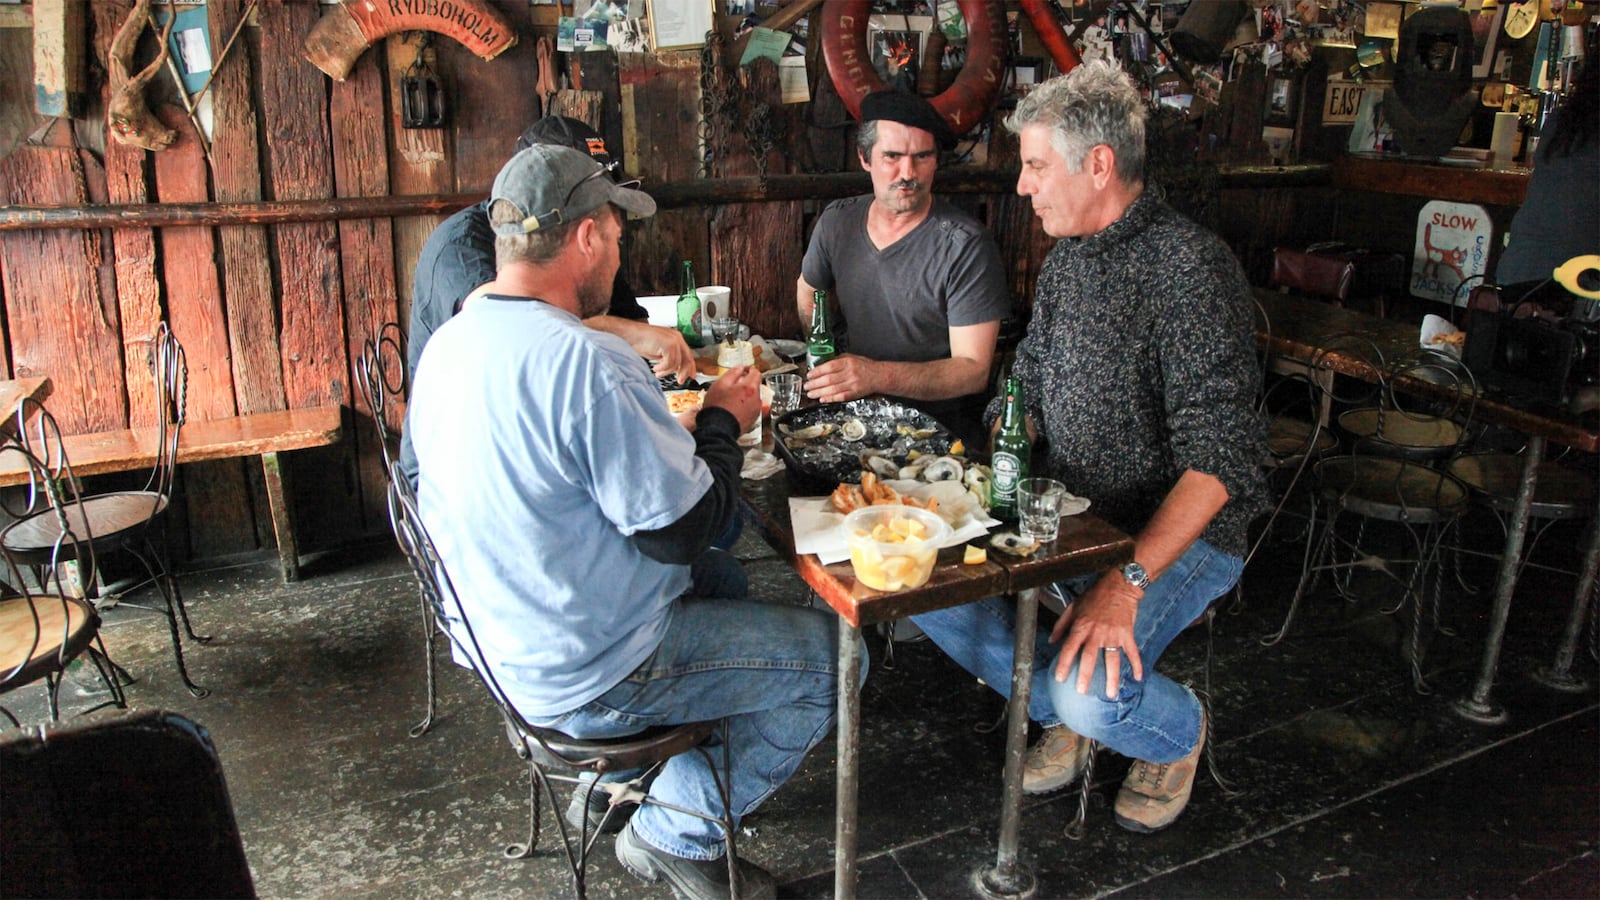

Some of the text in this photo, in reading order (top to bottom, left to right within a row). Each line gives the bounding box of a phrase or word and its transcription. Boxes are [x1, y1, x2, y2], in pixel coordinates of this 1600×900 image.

[388, 0, 499, 46] RYDBOHOLM
[1329, 87, 1366, 116] EAST
[1431, 212, 1478, 232] SLOW
